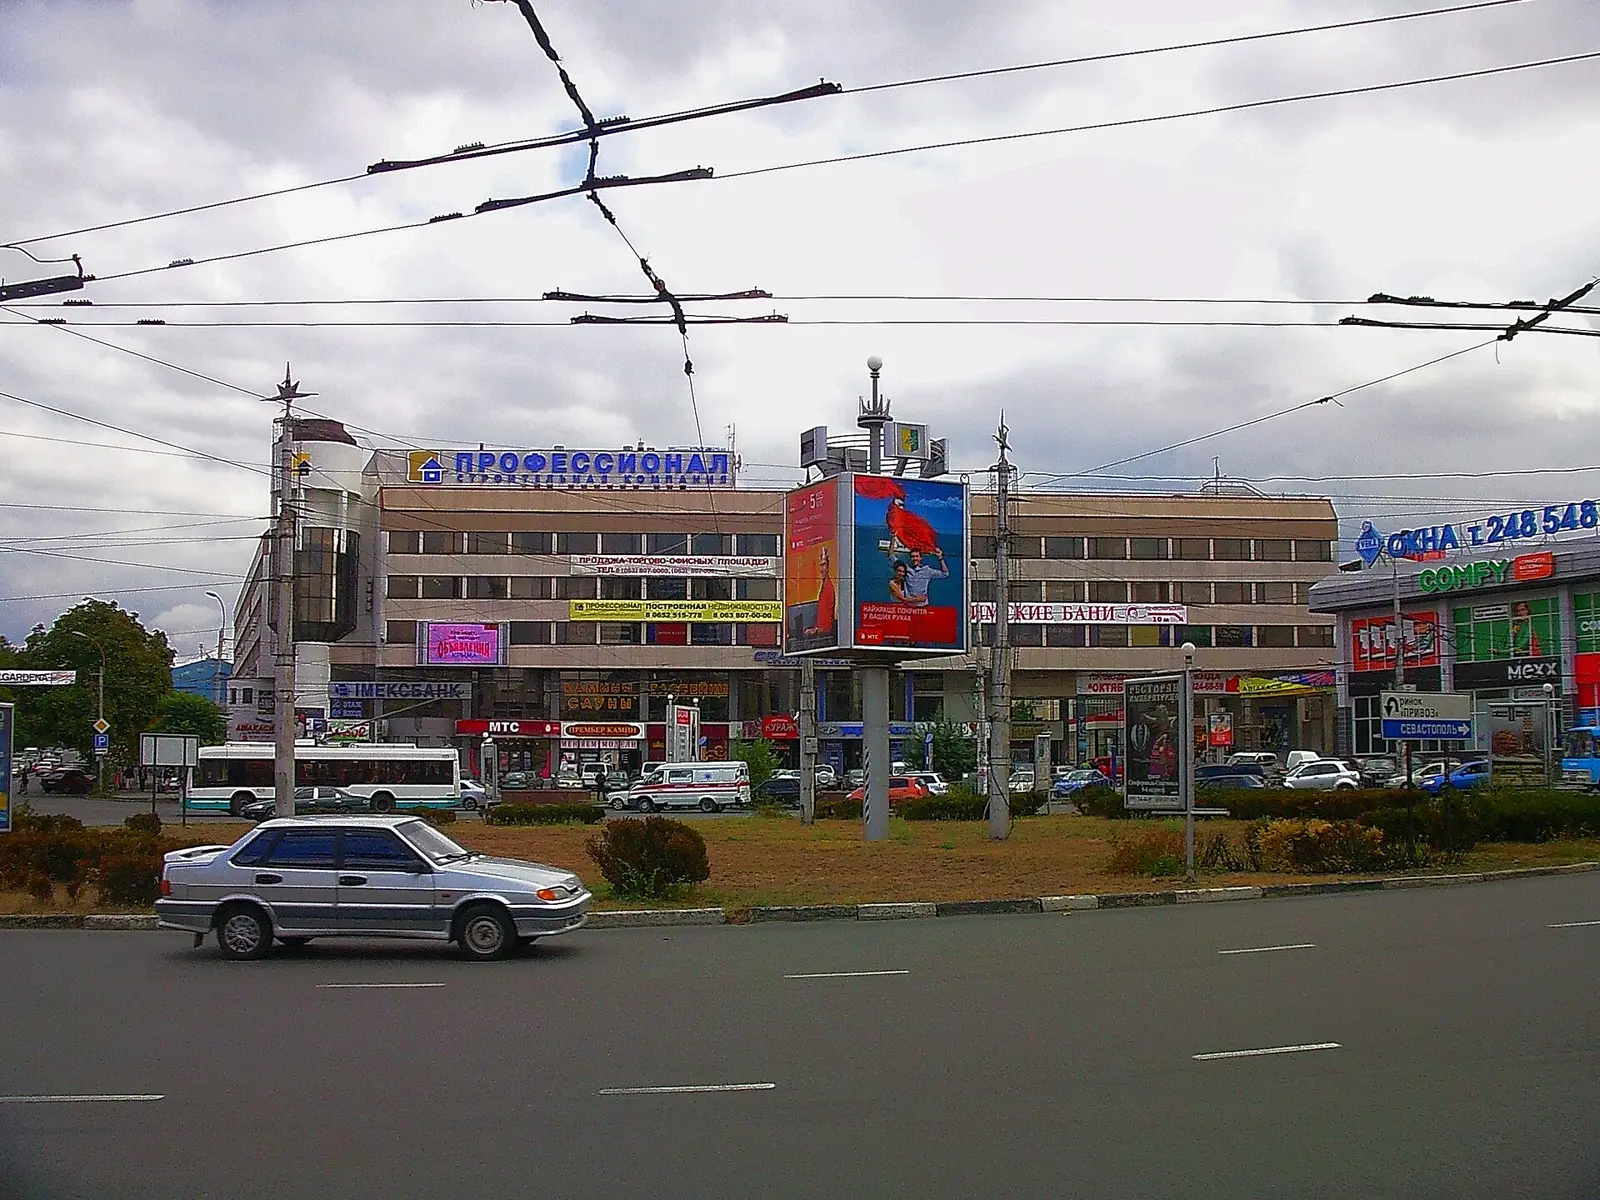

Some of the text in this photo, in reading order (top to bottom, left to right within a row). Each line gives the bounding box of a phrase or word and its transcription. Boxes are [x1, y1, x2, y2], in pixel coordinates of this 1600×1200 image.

[456, 452, 728, 473] ПРОФЕССИОНАЛ
[457, 474, 727, 483] СТРОИТЕЛЬНАЯ КОМПАНИЯ
[1387, 523, 1461, 558] ОКНА
[1487, 510, 1538, 543] 248
[1543, 499, 1598, 535] 548
[717, 558, 769, 566] ПЛОЩАДЕЙ
[1419, 559, 1509, 592] COMFY
[863, 604, 897, 614] НАЙКРАЩЕ
[897, 607, 928, 615] ПОКРИТТЯ
[1062, 605, 1116, 621] БАНИ
[563, 682, 633, 694] КАМИНЫ
[567, 697, 632, 710] САУНЫ
[488, 721, 520, 732] МТС
[1400, 723, 1458, 735] СЕВАСТОПОЛЬ
